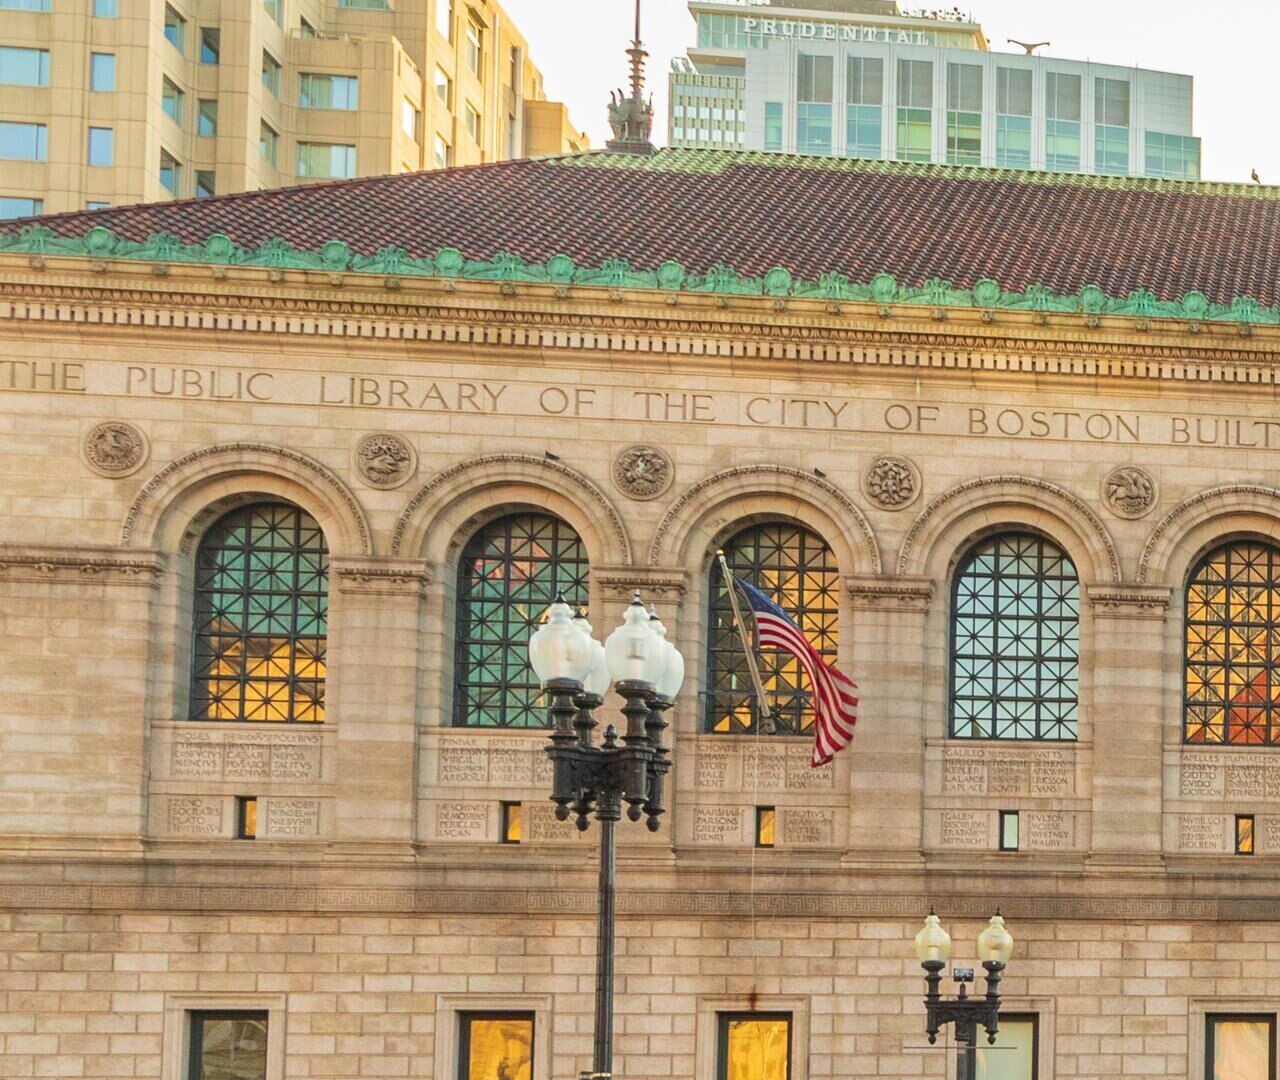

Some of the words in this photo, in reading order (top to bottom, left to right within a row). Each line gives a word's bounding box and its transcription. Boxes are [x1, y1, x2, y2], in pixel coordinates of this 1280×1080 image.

[744, 17, 929, 45] PRUDENTIAL
[0, 360, 87, 392] THE
[125, 366, 274, 400] PUBLIC
[319, 375, 507, 412] LIBRARY
[539, 387, 596, 415] OF
[635, 391, 716, 422] THE
[745, 397, 849, 428] CITY
[884, 404, 940, 432] OF
[968, 408, 1141, 442] BOSTON
